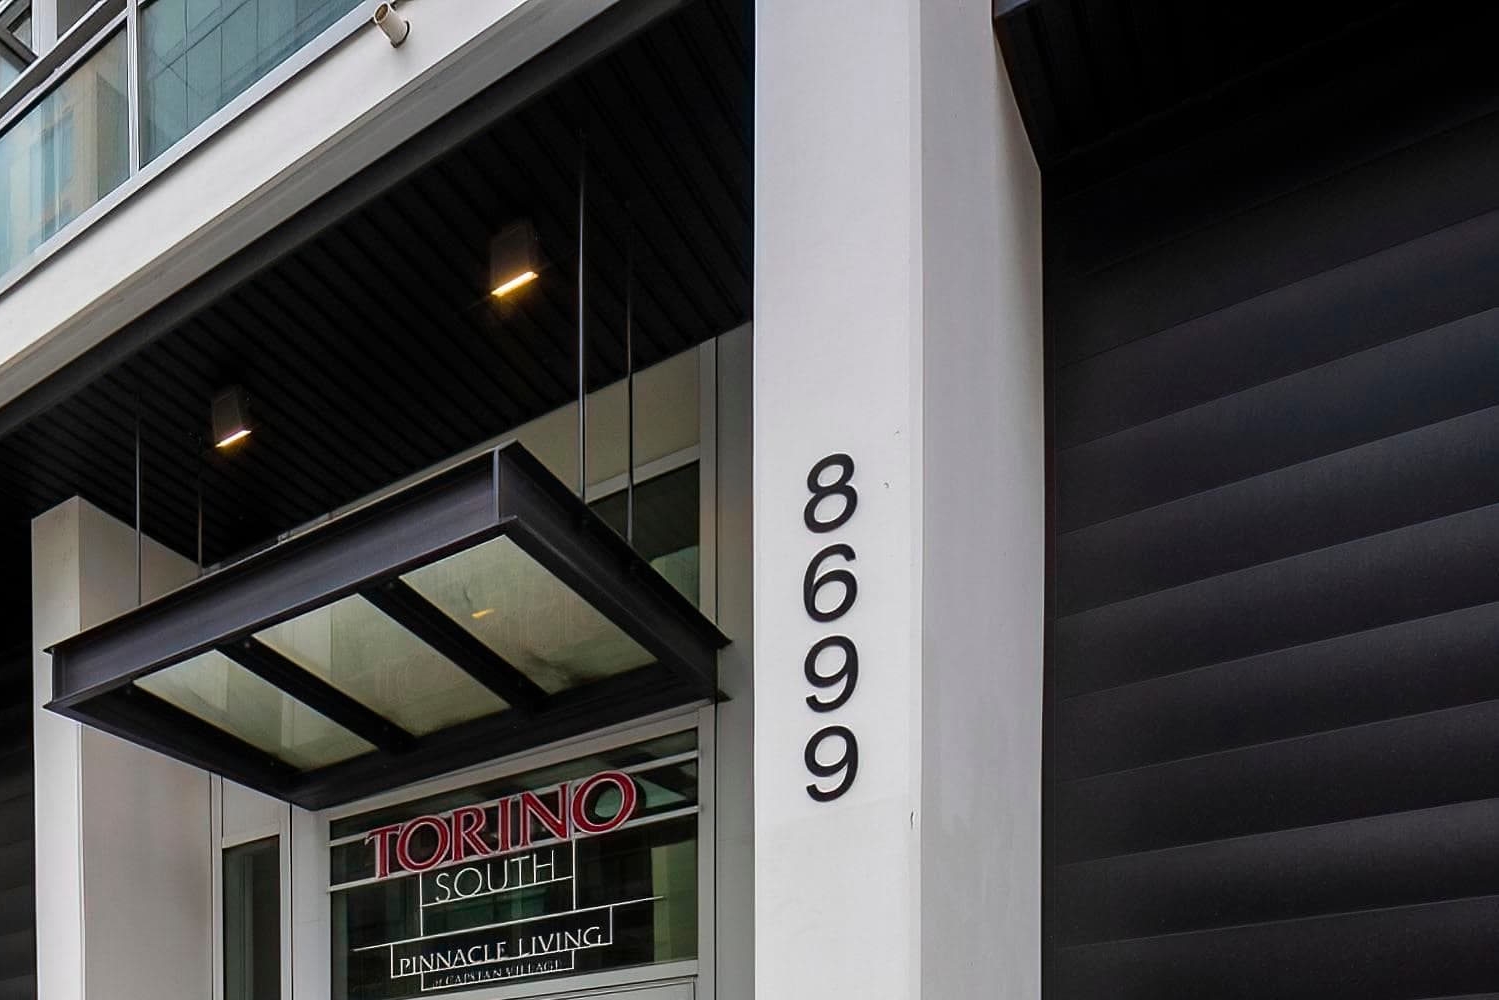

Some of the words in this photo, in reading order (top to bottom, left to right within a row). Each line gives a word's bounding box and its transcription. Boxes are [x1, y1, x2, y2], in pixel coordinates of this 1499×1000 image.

[803, 453, 859, 803] 8699
[364, 770, 637, 880] TORINO
[434, 850, 555, 903] SOUTH
[399, 941, 510, 976] PINNACLE
[518, 926, 602, 957] LIVING
